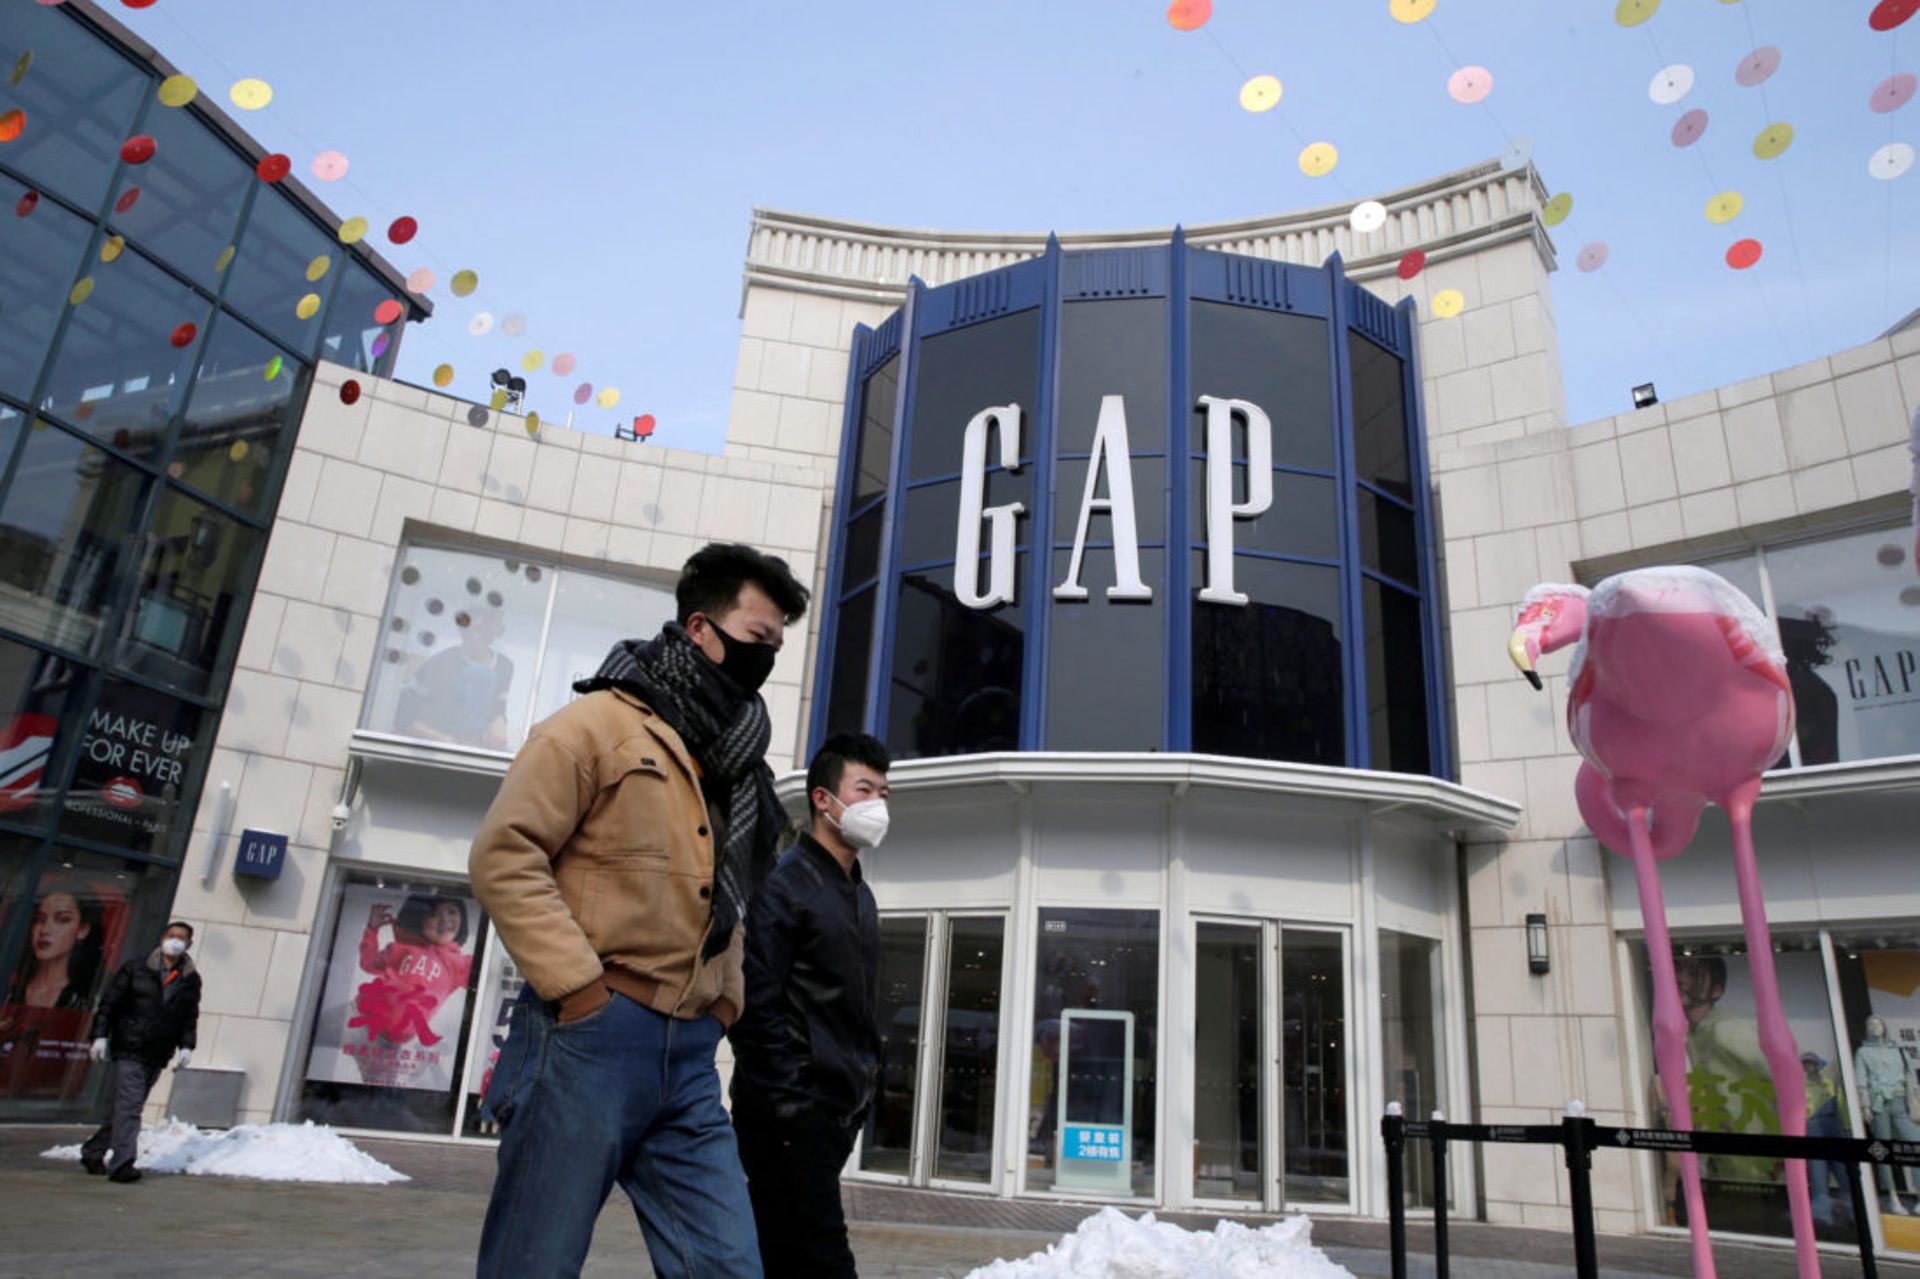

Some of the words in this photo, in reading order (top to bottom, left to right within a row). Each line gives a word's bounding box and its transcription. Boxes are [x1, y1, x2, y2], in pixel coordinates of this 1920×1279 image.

[953, 394, 1273, 610] GAP
[1845, 650, 1916, 699] GAP
[89, 708, 158, 747] MAKE
[161, 730, 191, 756] UP
[82, 734, 125, 768] FOR
[129, 751, 183, 784] EVER
[246, 841, 278, 866] GAP
[399, 955, 443, 981] GAP
